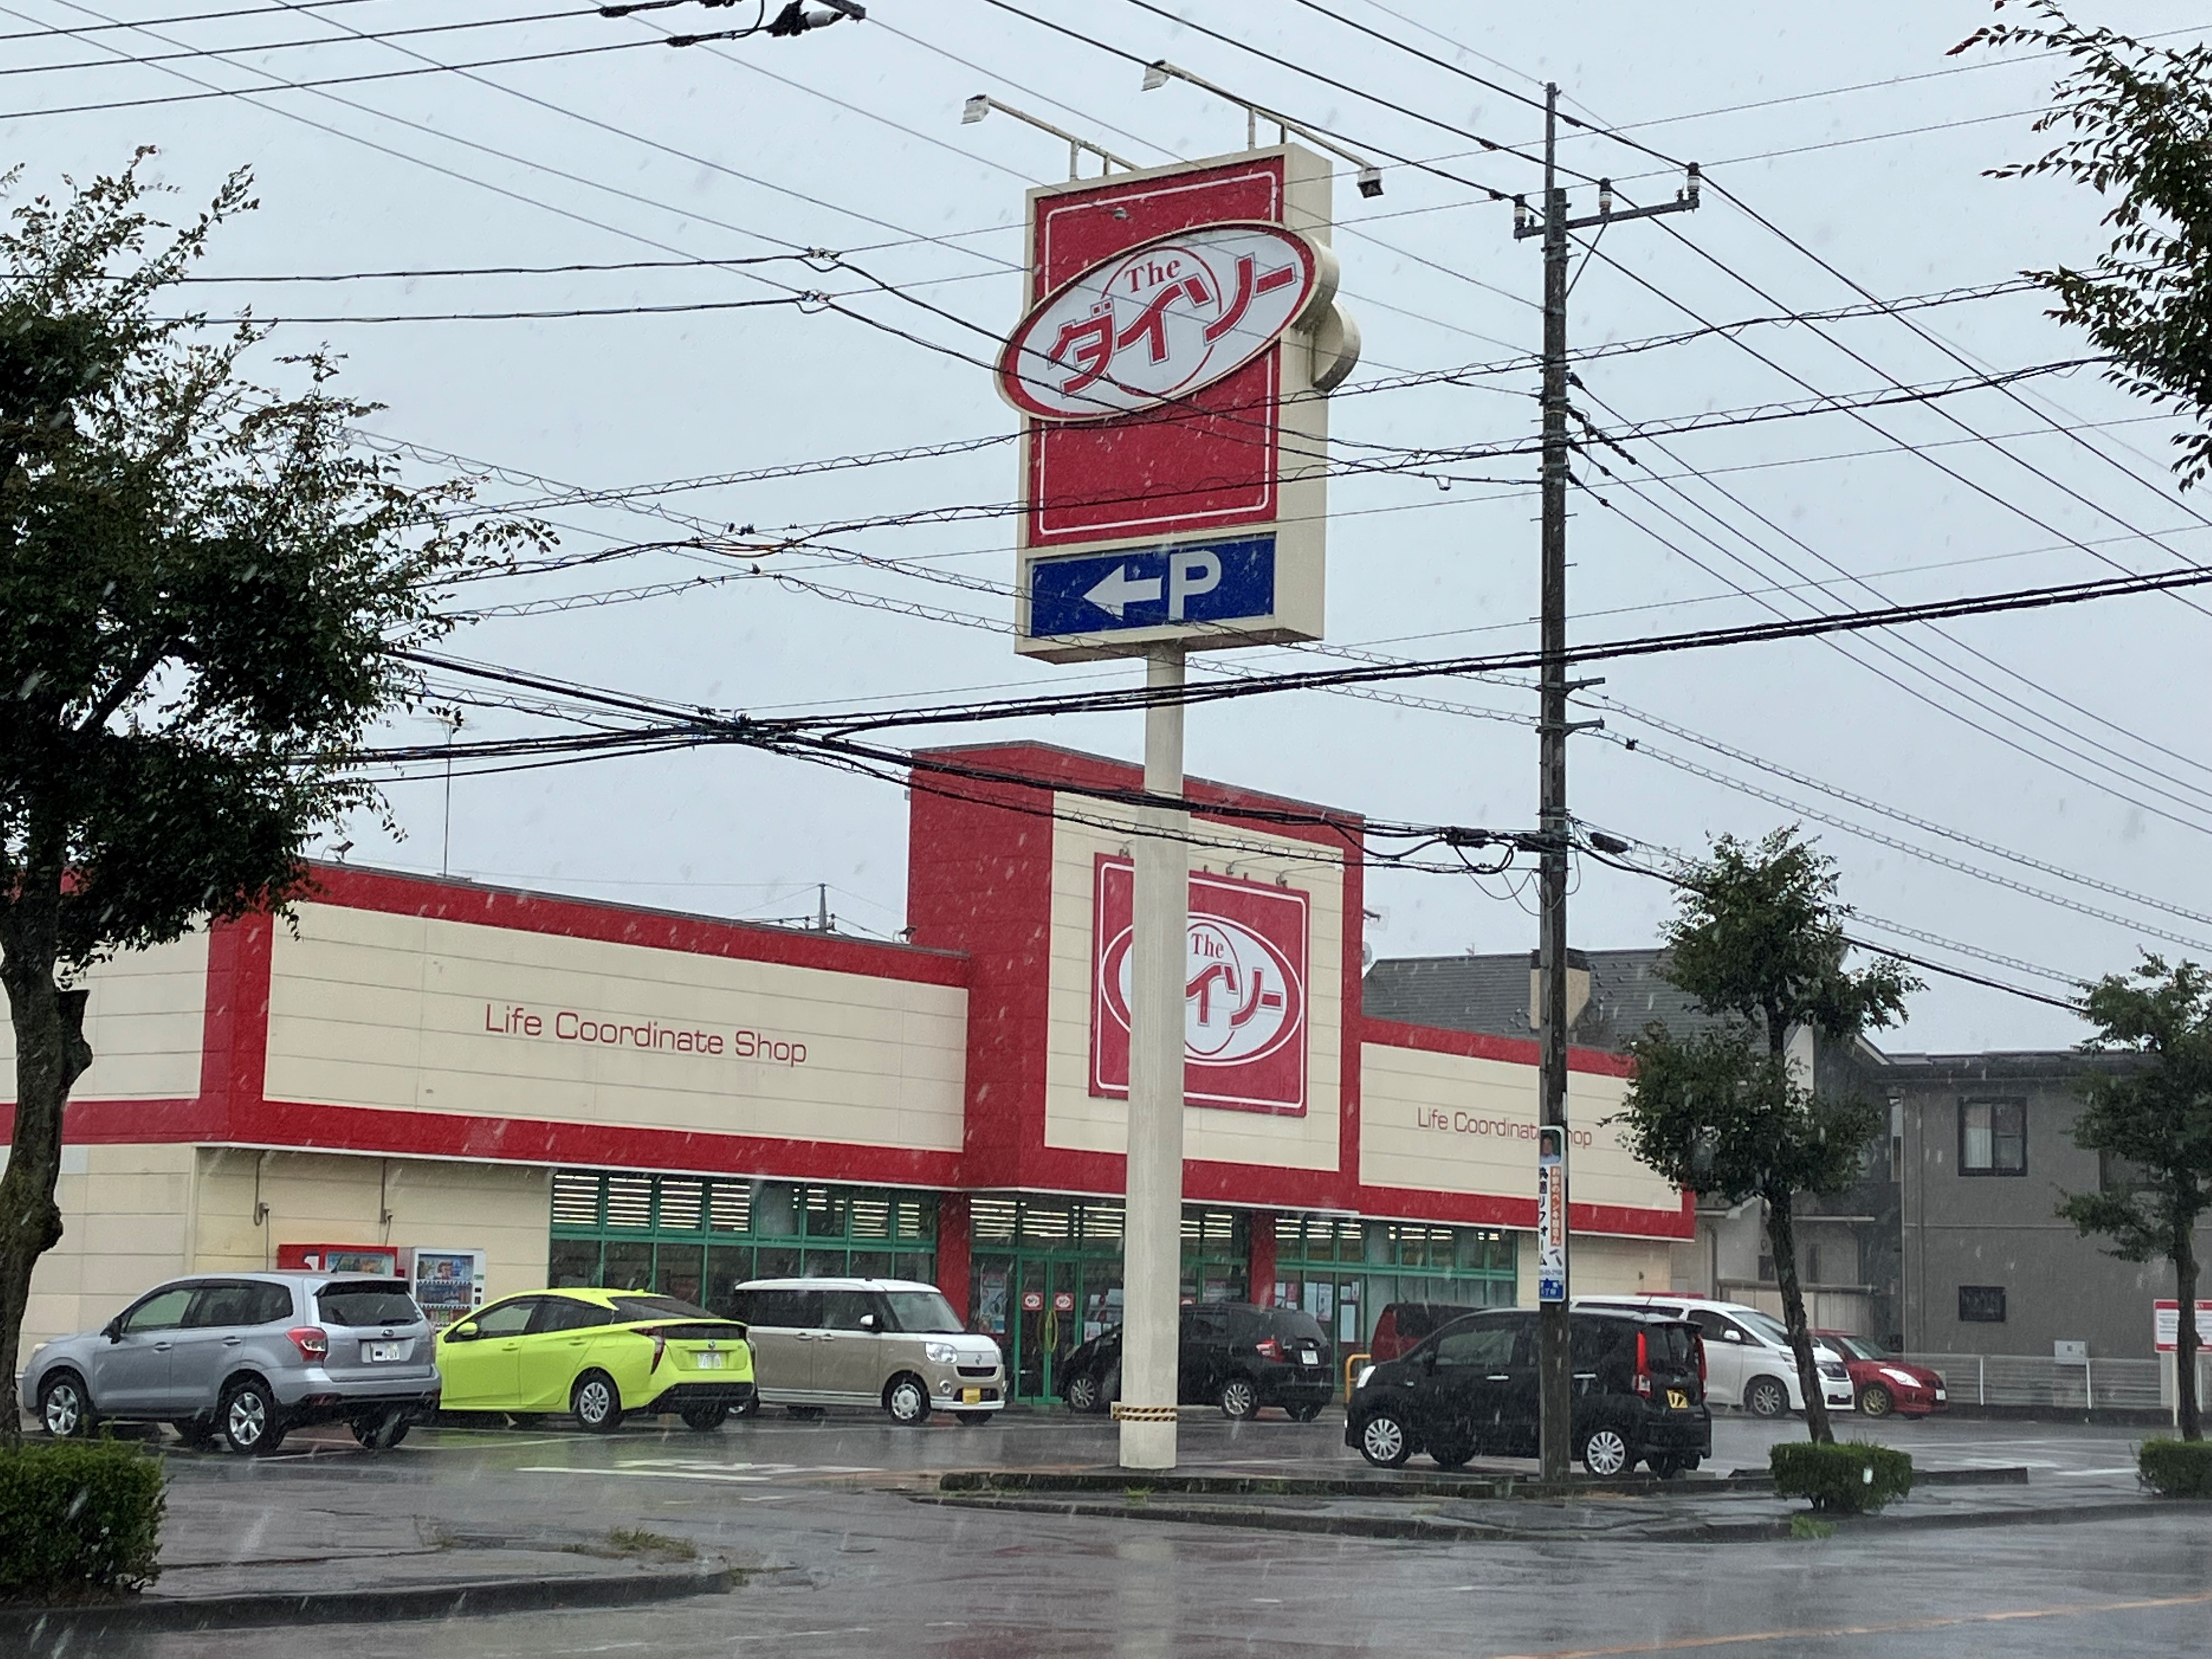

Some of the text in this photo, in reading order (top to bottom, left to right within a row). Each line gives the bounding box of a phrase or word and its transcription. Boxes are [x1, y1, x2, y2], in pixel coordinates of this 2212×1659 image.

[1124, 258, 1181, 294] The
[1047, 251, 1299, 398] ダイソー
[1169, 550, 1222, 620] P
[1191, 933, 1224, 959] The
[1186, 962, 1284, 1029] イソー
[485, 1003, 807, 1068] Life Coordinate Shop
[1418, 1107, 1448, 1130] Life
[1454, 1111, 1540, 1140] Coordinat
